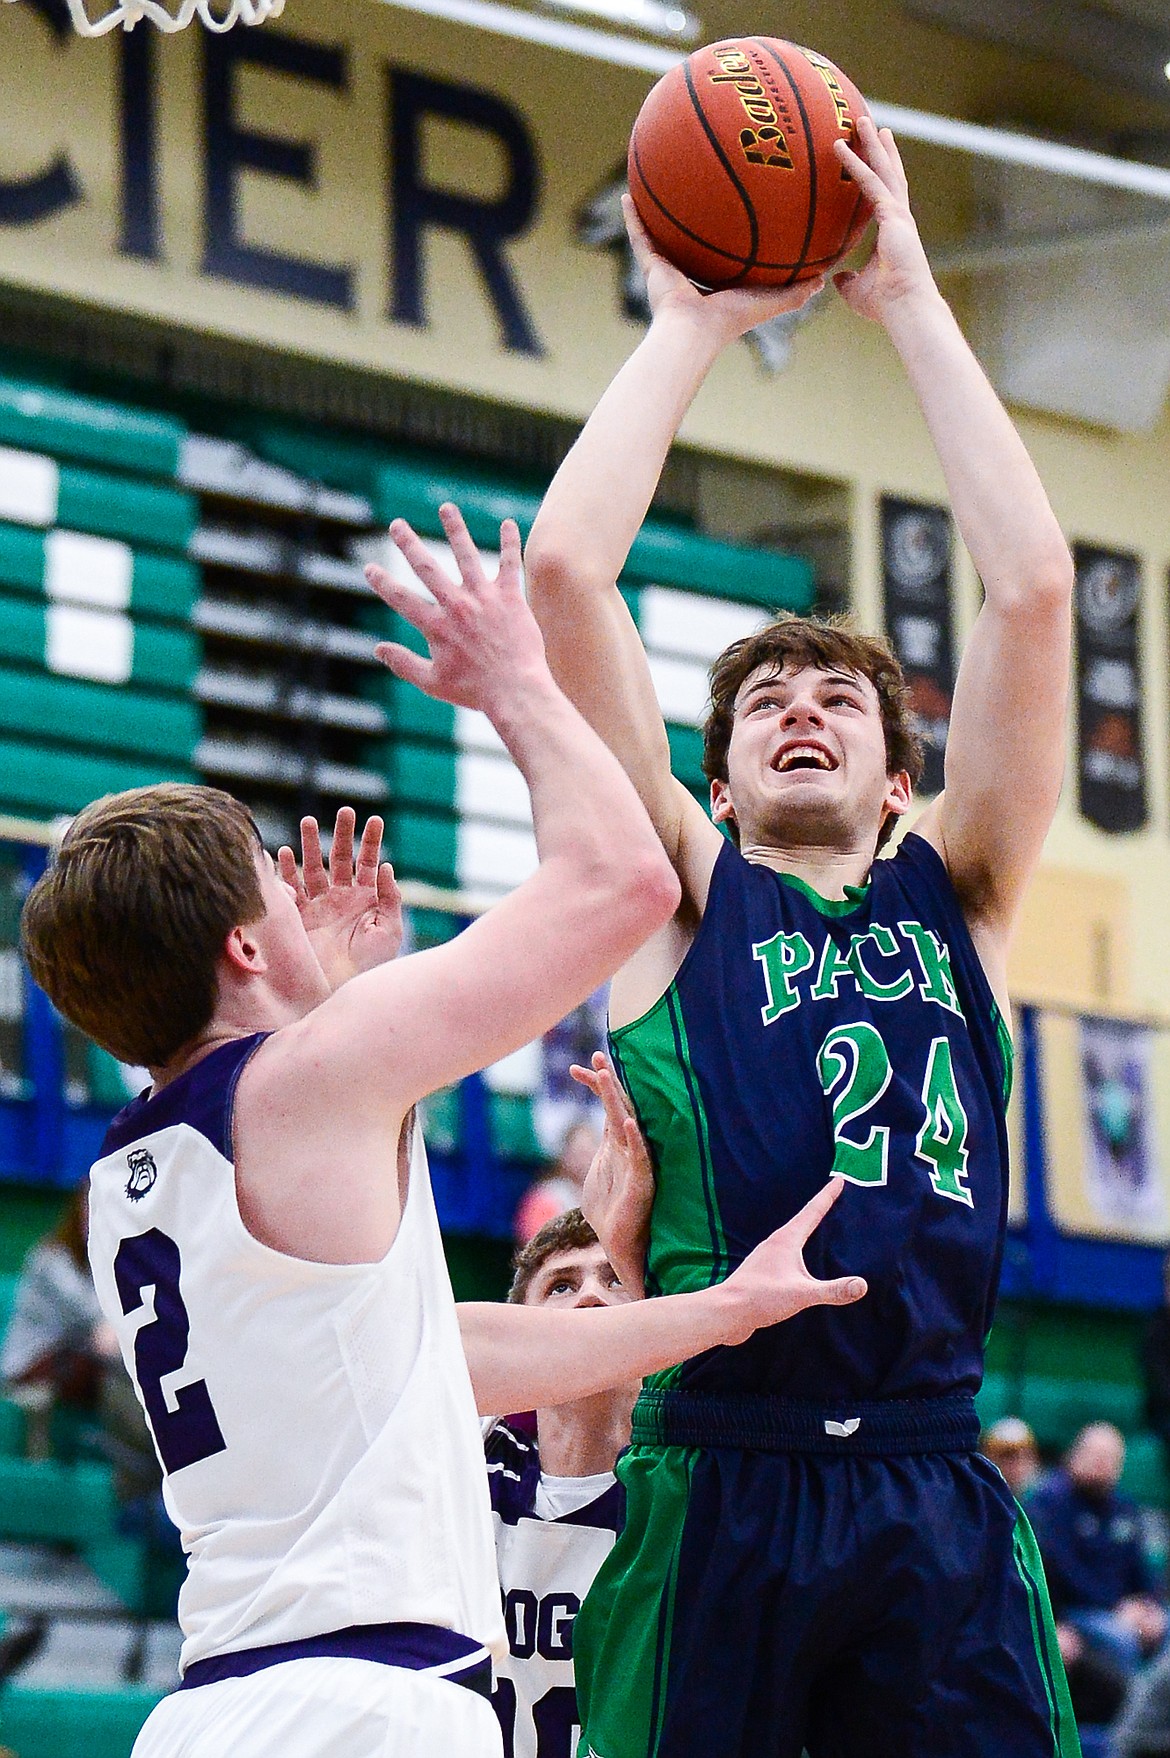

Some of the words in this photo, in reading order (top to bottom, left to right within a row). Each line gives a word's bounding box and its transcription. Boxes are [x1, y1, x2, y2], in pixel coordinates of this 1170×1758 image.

[711, 46, 794, 171] Baden
[752, 921, 966, 1026] PACK
[816, 1021, 974, 1208] 24
[114, 1227, 227, 1476] 2
